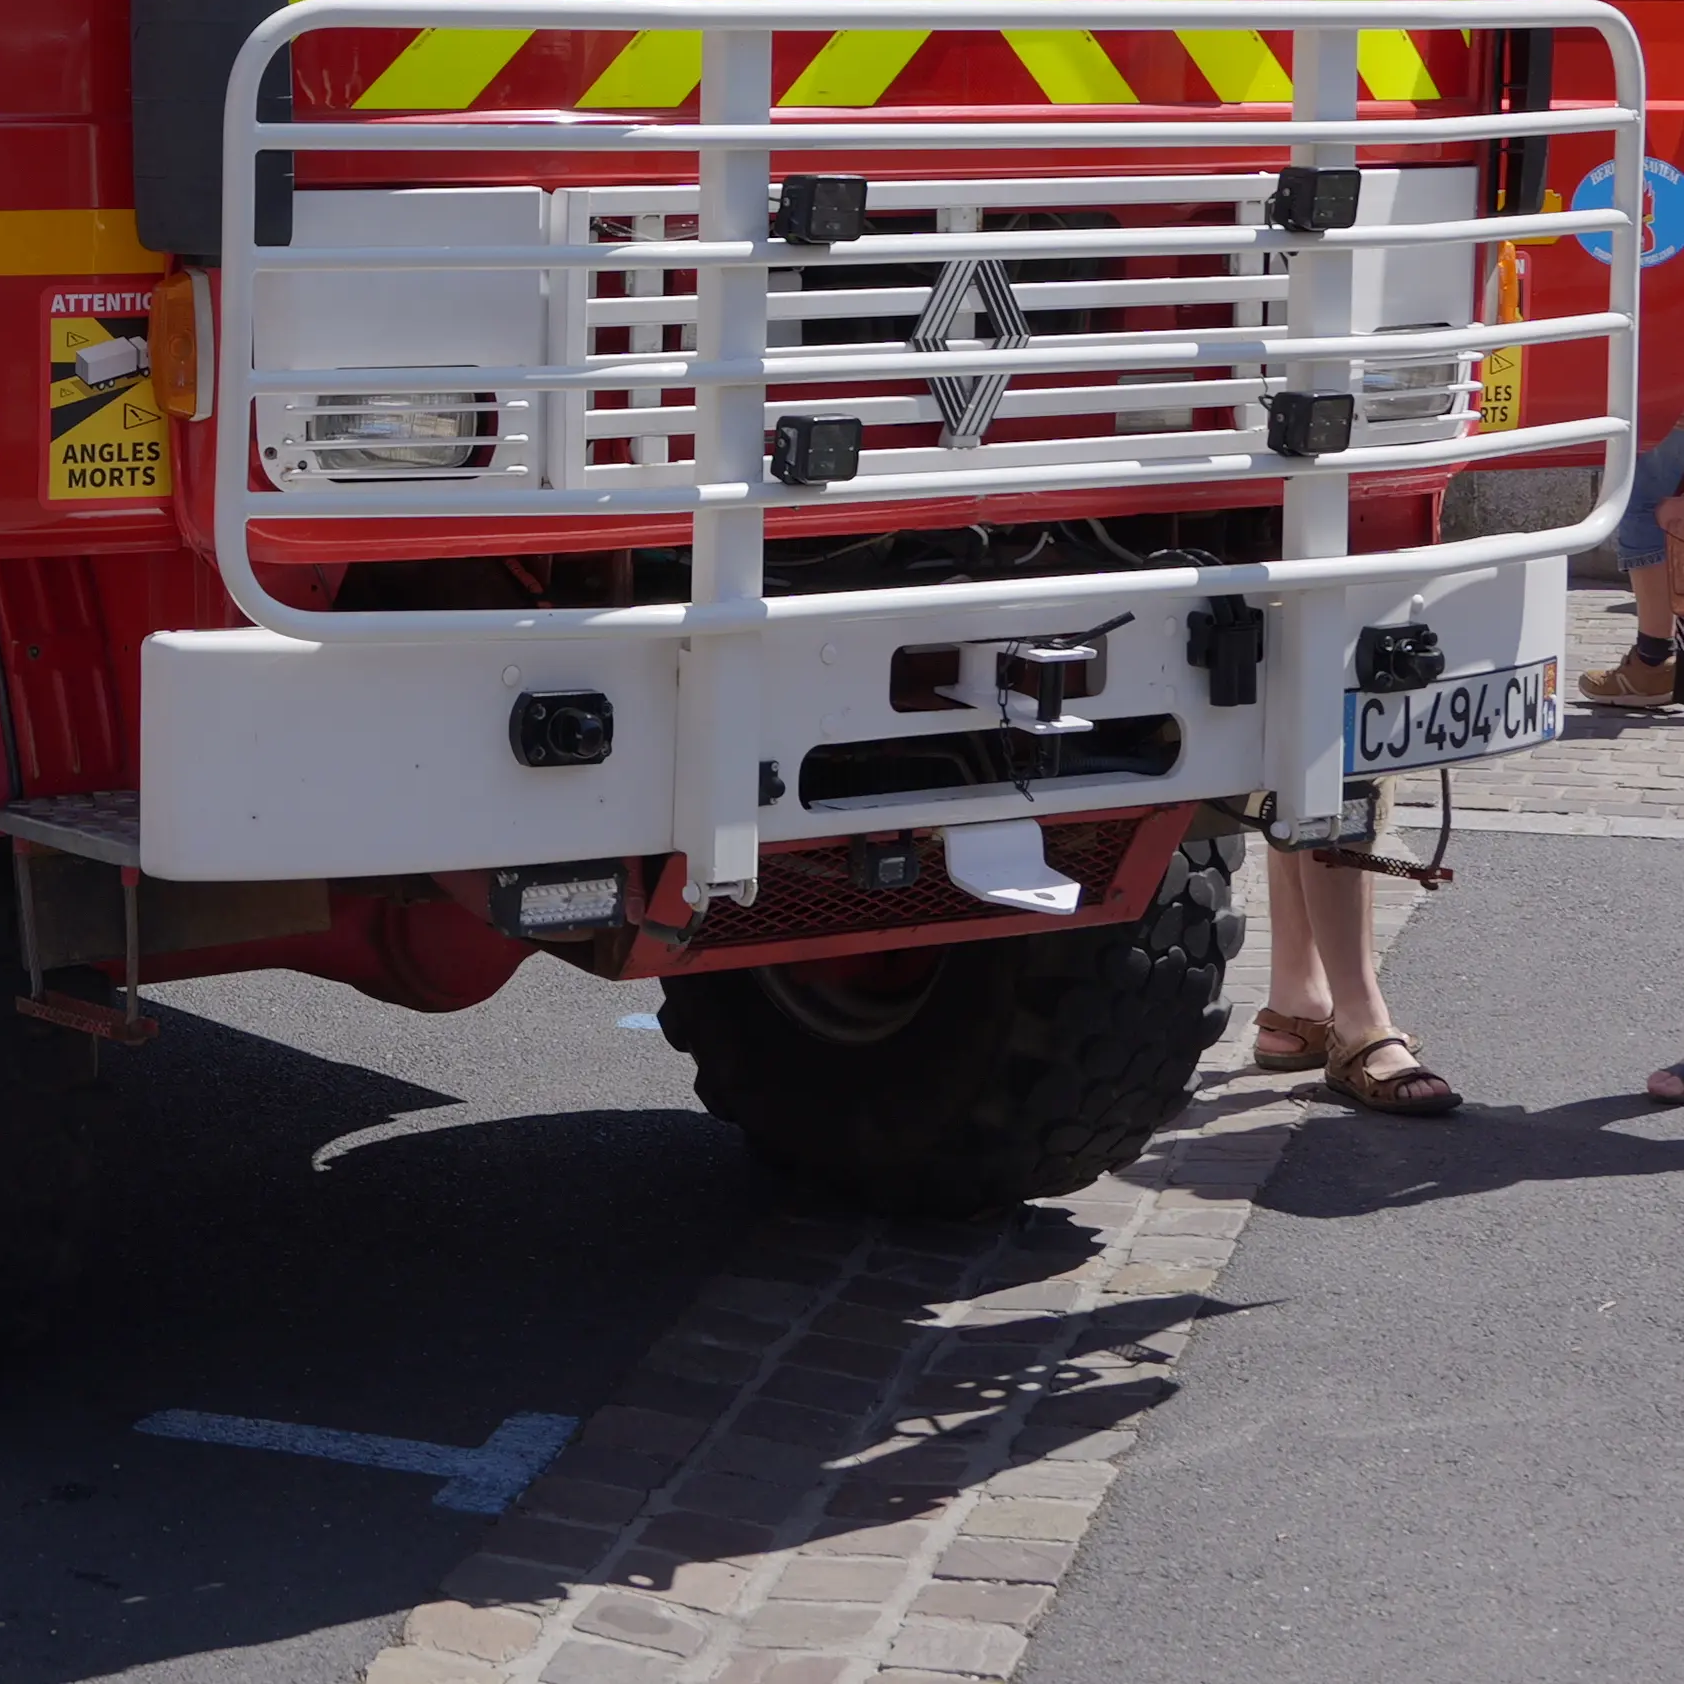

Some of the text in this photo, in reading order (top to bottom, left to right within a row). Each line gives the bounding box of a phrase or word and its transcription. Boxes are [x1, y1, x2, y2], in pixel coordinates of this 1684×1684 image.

[1480, 406, 1508, 423] RTS
[62, 441, 161, 465] ANGLES
[67, 467, 157, 490] MORTS
[1359, 672, 1539, 762] CJ-494-CW
